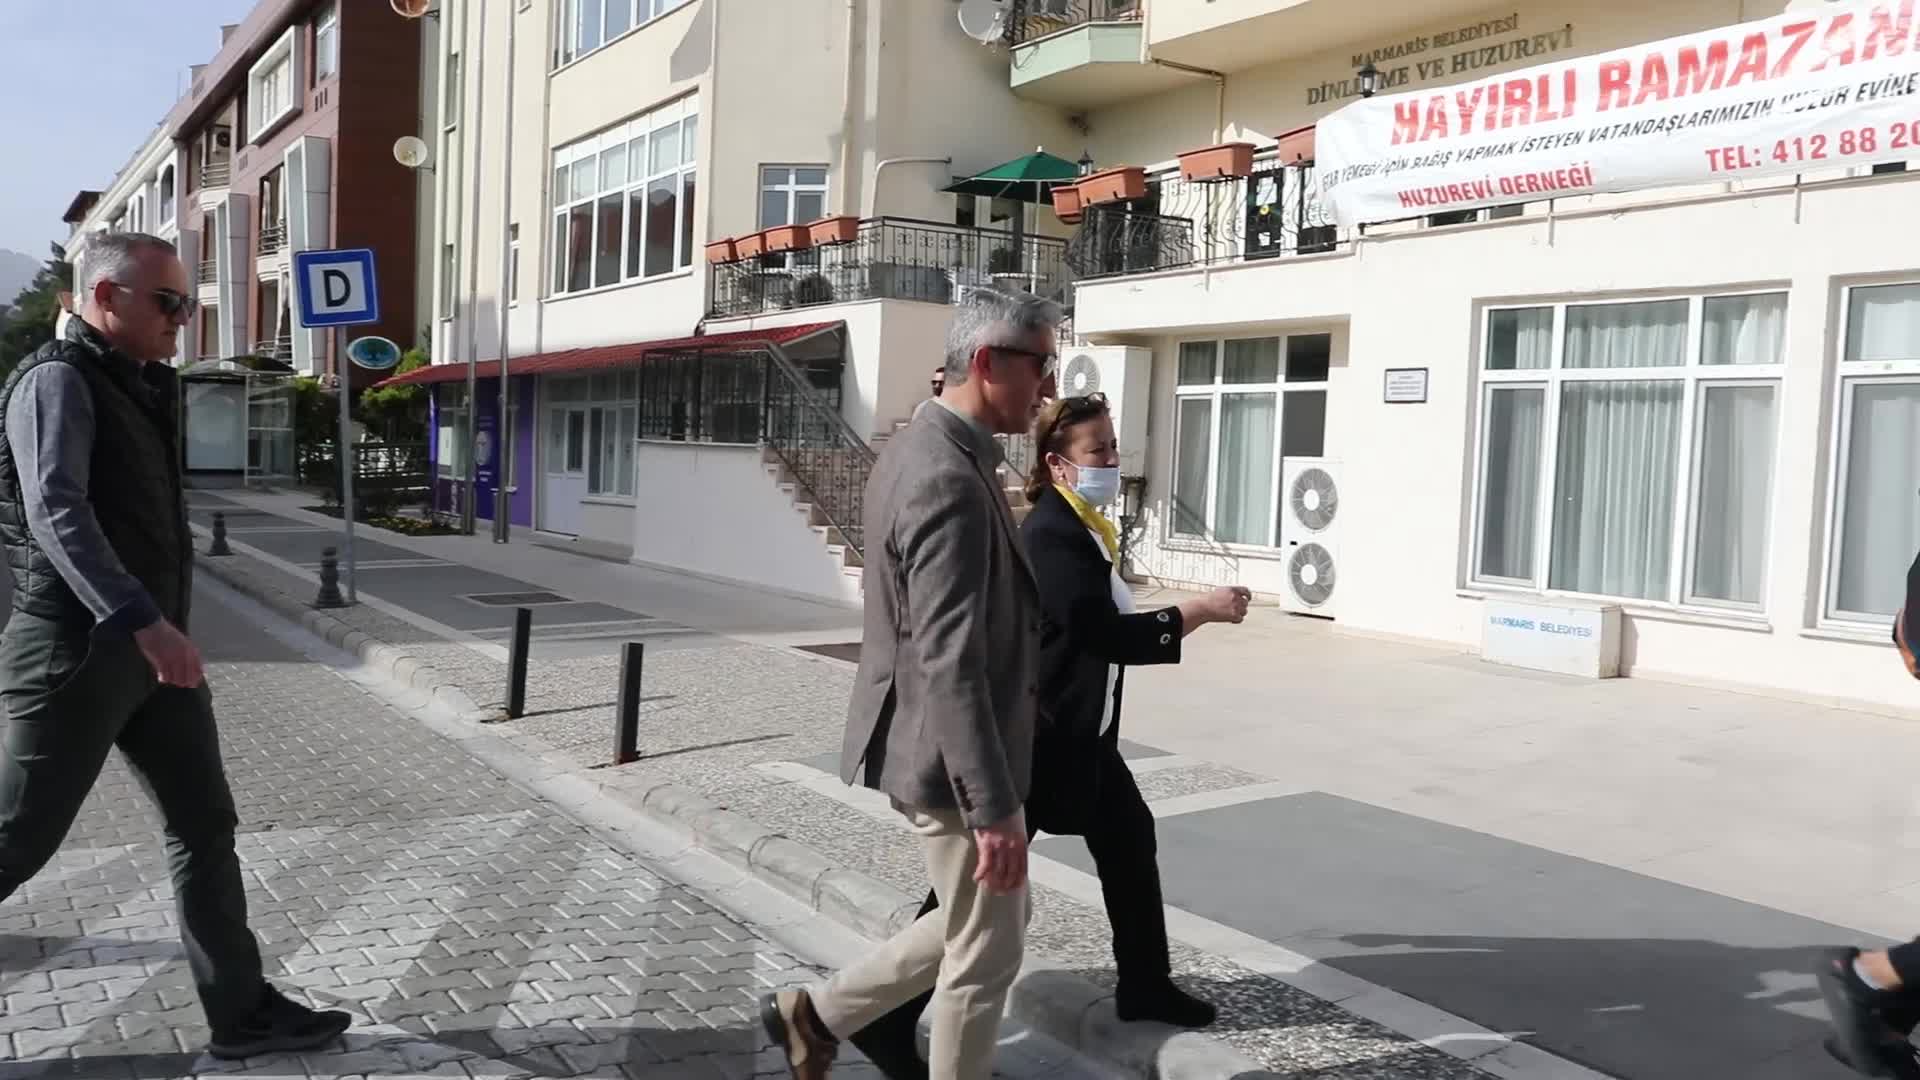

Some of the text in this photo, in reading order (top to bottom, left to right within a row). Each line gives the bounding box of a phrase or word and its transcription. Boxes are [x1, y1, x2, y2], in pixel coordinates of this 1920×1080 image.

[1306, 23, 1574, 105] DİNLEME VE HUZUREVİ
[1391, 0, 1920, 145] HAYIRLI RAMAZAN
[1456, 141, 1517, 163] YAPMAK
[1519, 130, 1585, 153] İSTEYEN
[1588, 97, 1776, 142] VATANDAŞLARIMIZIN
[1855, 72, 1919, 102] EVİNE
[1706, 147, 1761, 172] TEL:
[1772, 134, 1827, 163] 412
[1839, 127, 1876, 155] 88
[1398, 161, 1594, 208] HUZUREVİ DERNEĞİ
[322, 269, 351, 307] D
